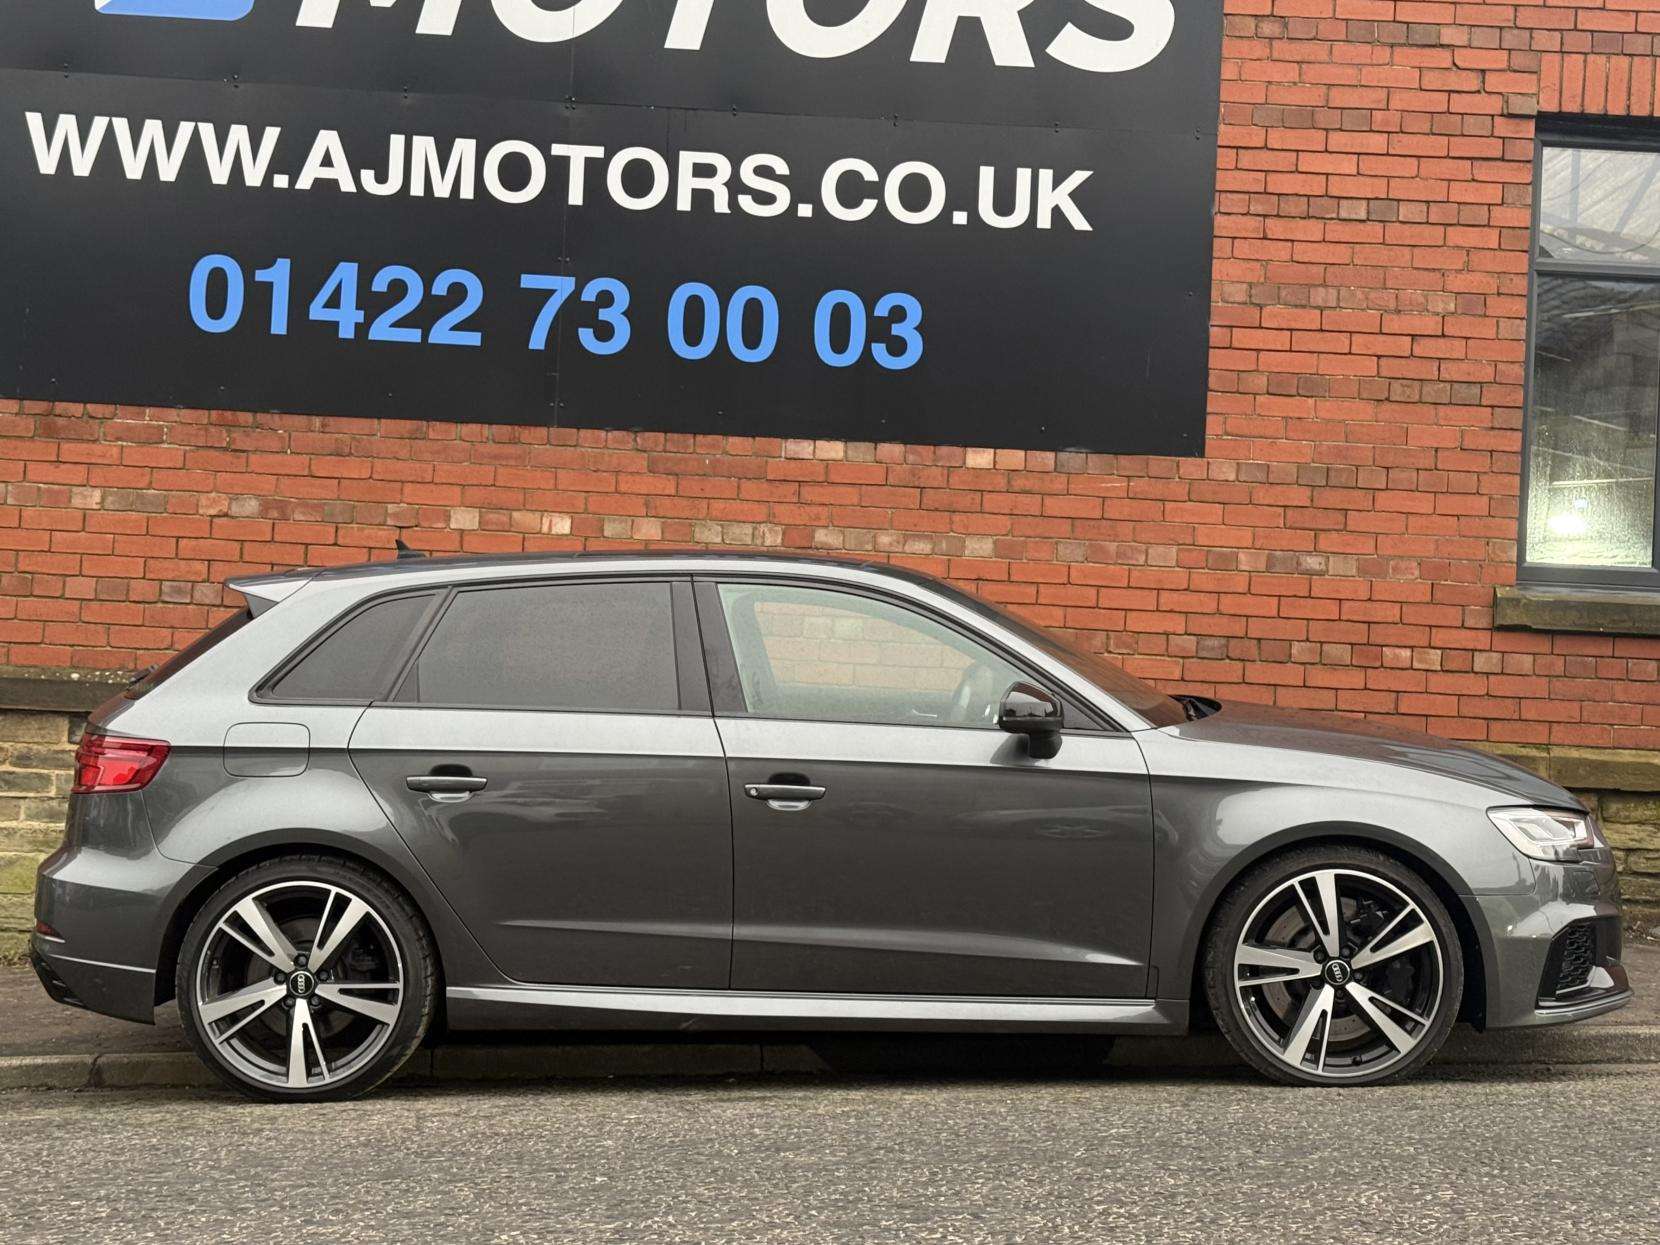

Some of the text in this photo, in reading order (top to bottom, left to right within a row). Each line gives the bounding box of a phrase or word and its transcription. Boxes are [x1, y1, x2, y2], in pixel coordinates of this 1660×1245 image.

[24, 111, 1093, 232] WWW.AJMOTORS.CO.UK
[189, 253, 924, 370] 01422 73 00 03
